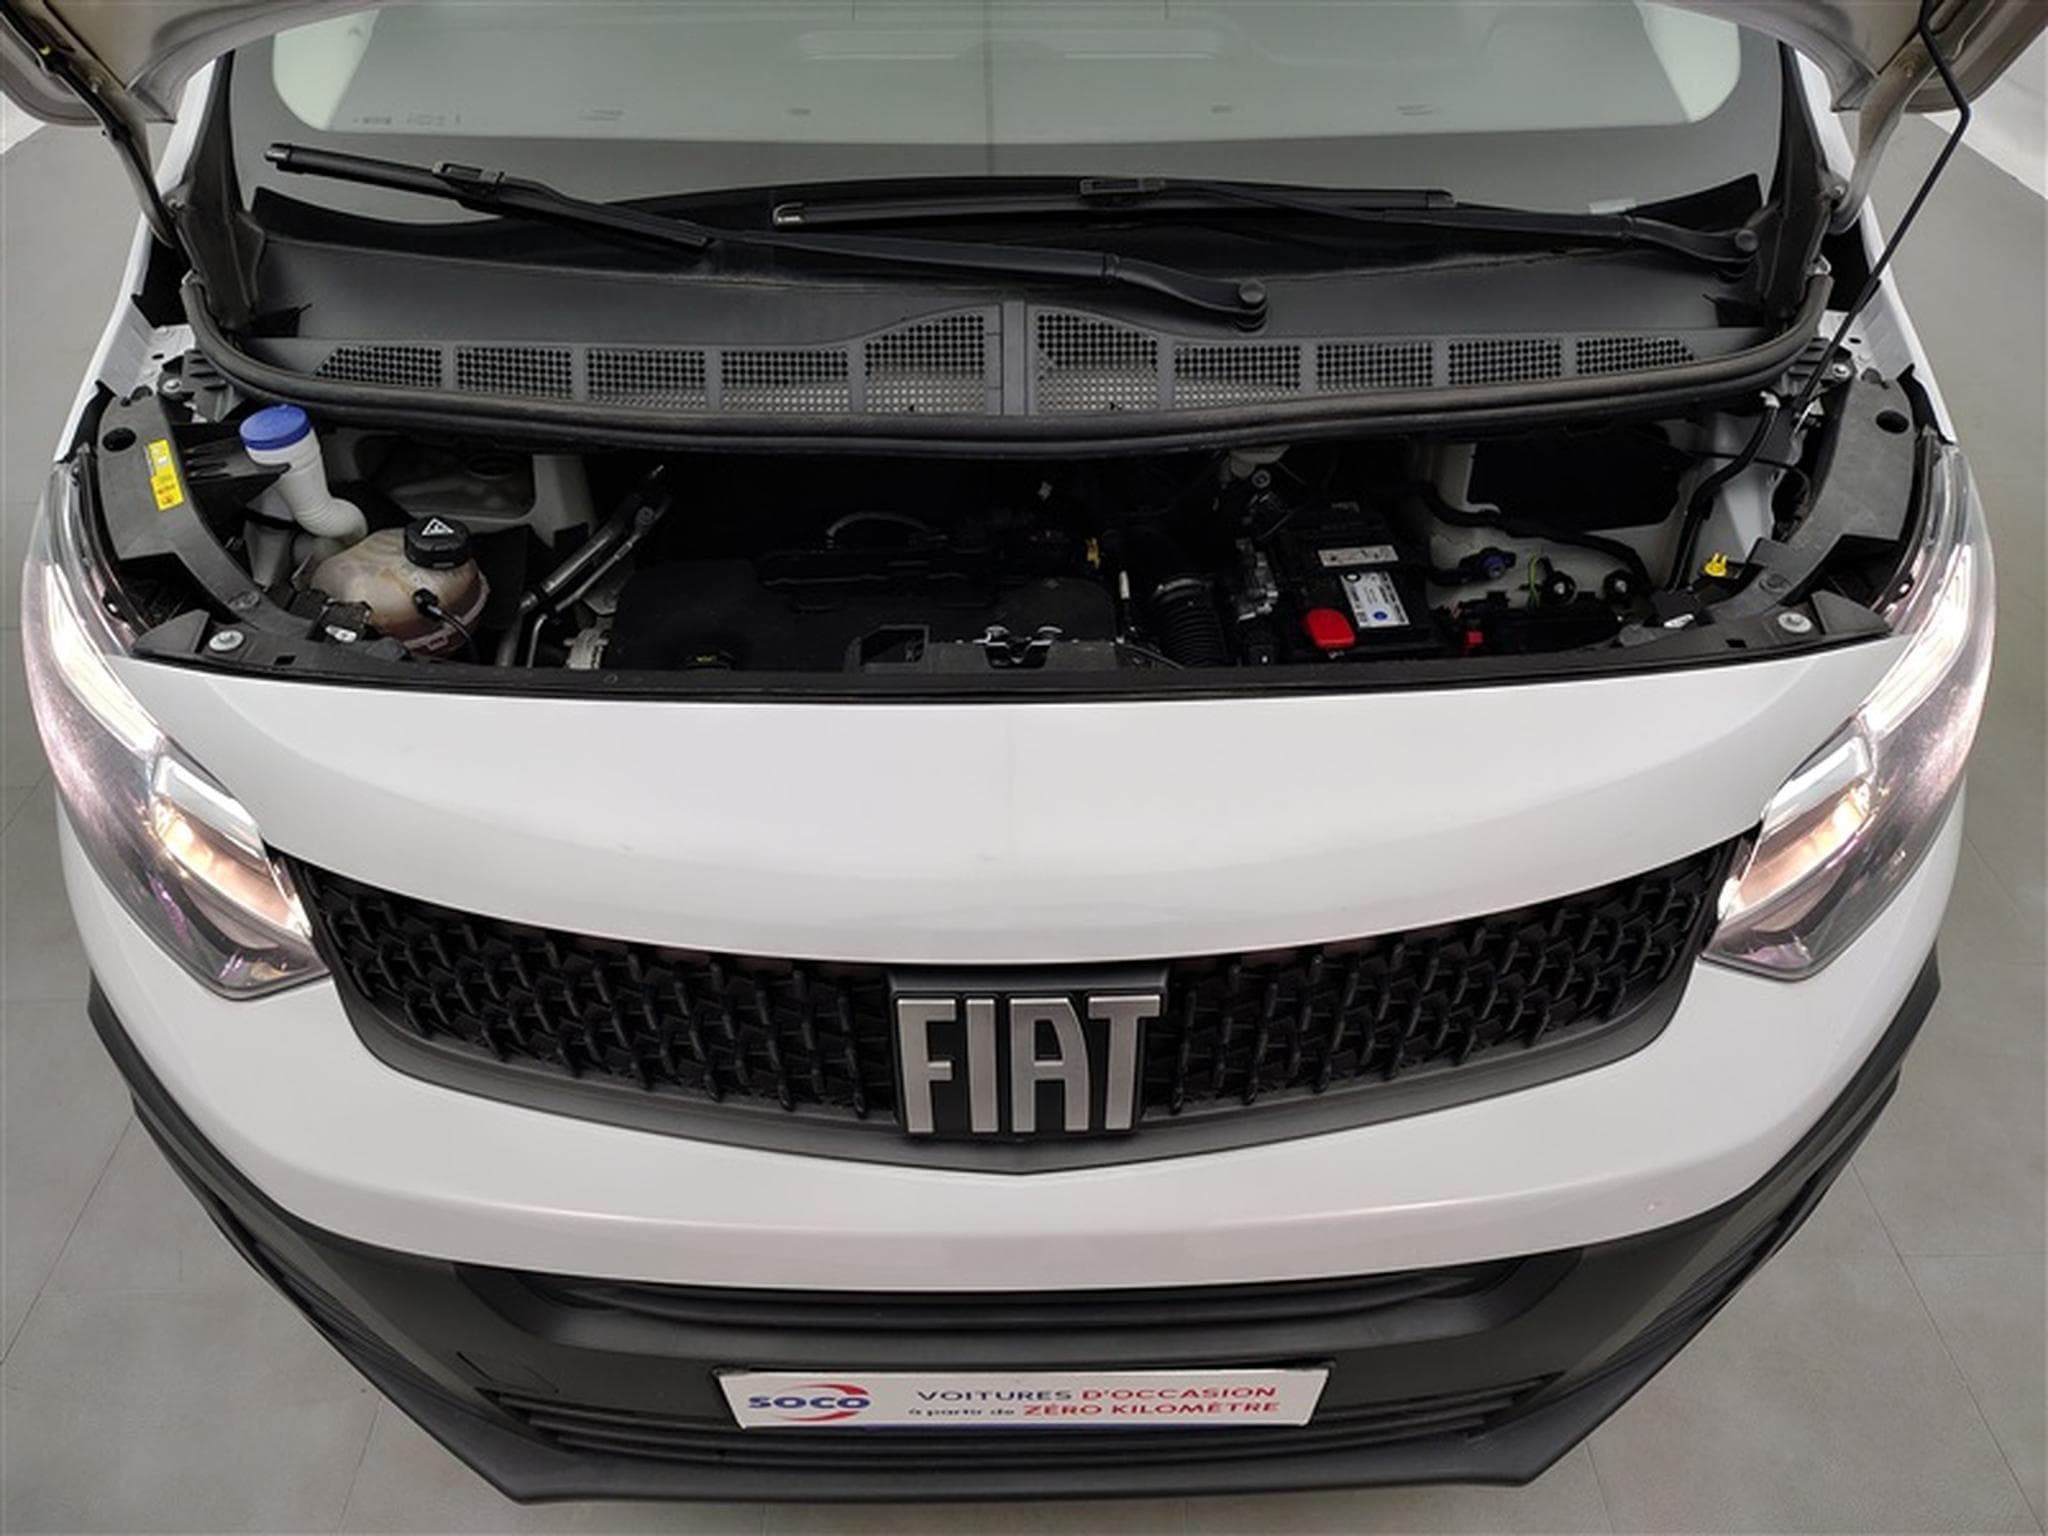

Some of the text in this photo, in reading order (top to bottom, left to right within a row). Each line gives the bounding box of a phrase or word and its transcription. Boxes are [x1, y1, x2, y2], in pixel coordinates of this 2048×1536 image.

[897, 995, 1161, 1133] FIAT
[917, 1387, 1277, 1401] VOITURES D'OCCASION
[747, 1396, 871, 1409] SOCO
